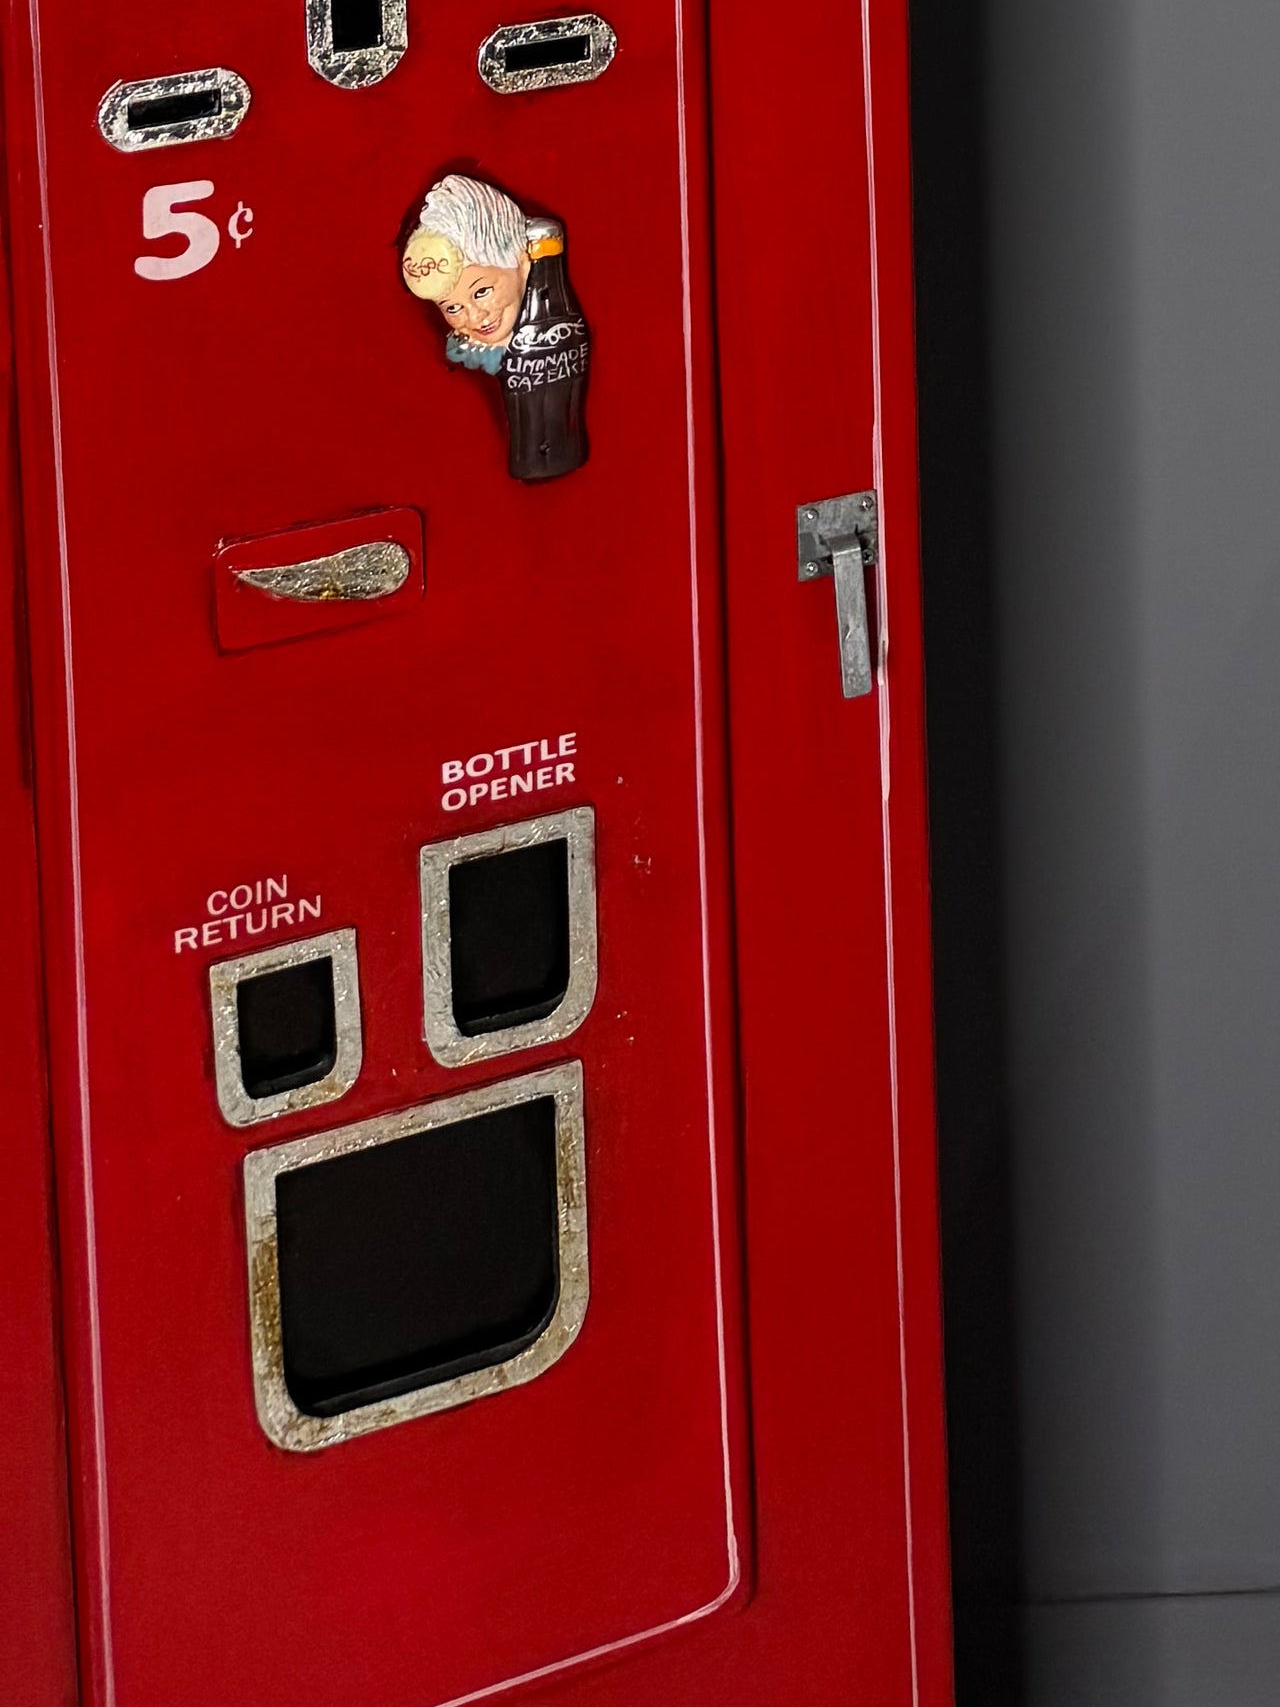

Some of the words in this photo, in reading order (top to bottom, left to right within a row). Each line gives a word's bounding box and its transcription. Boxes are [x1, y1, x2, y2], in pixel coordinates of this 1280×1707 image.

[442, 732, 577, 784] BOTTLE
[441, 762, 576, 811] OPENER
[207, 874, 288, 915] COIN
[174, 895, 321, 954] RETURN
